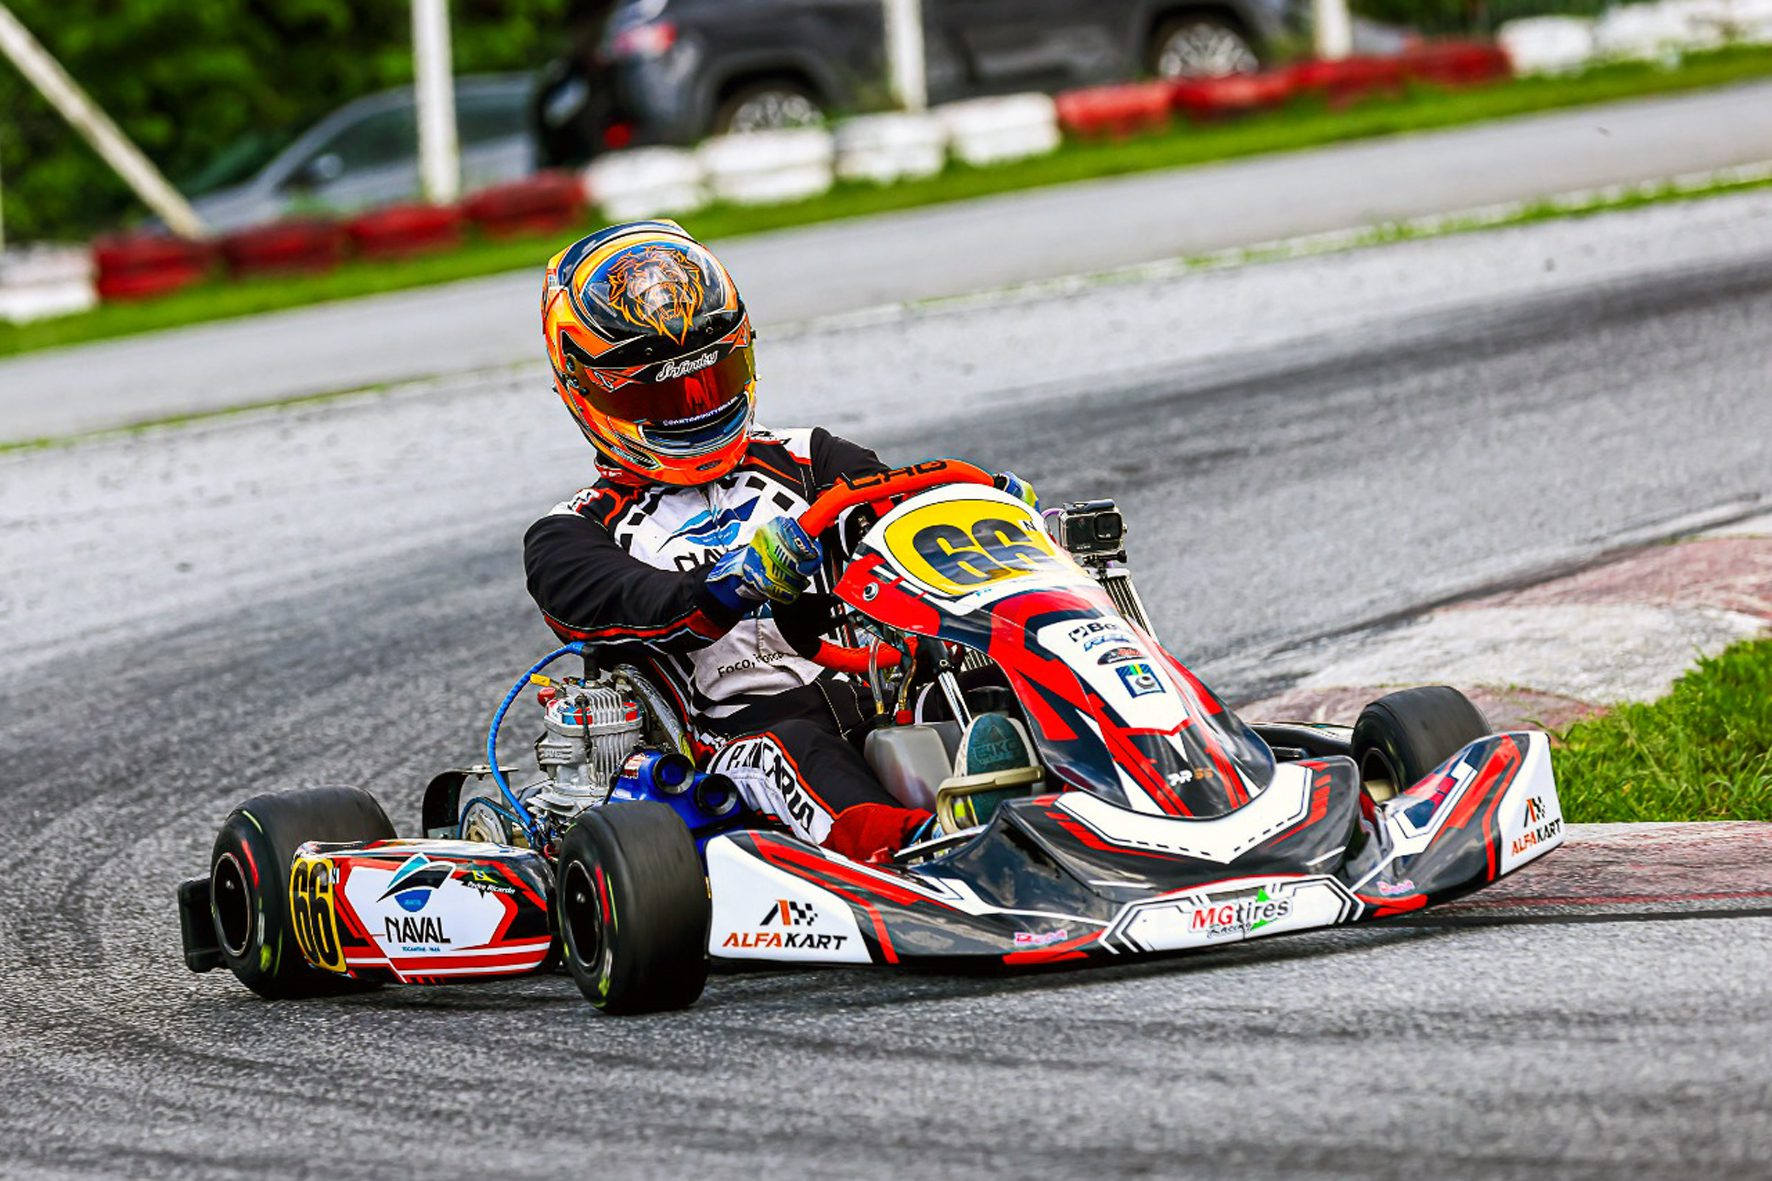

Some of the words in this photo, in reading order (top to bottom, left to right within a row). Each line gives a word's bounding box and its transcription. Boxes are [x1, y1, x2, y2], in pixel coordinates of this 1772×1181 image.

[912, 518, 1051, 585] 66
[717, 659, 756, 678] Foco,
[1512, 818, 1561, 856] ALFAKART
[291, 860, 340, 969] 66
[1192, 900, 1289, 929] MGtires
[384, 916, 452, 943] NAVAL
[722, 932, 848, 950] ALFAKART
